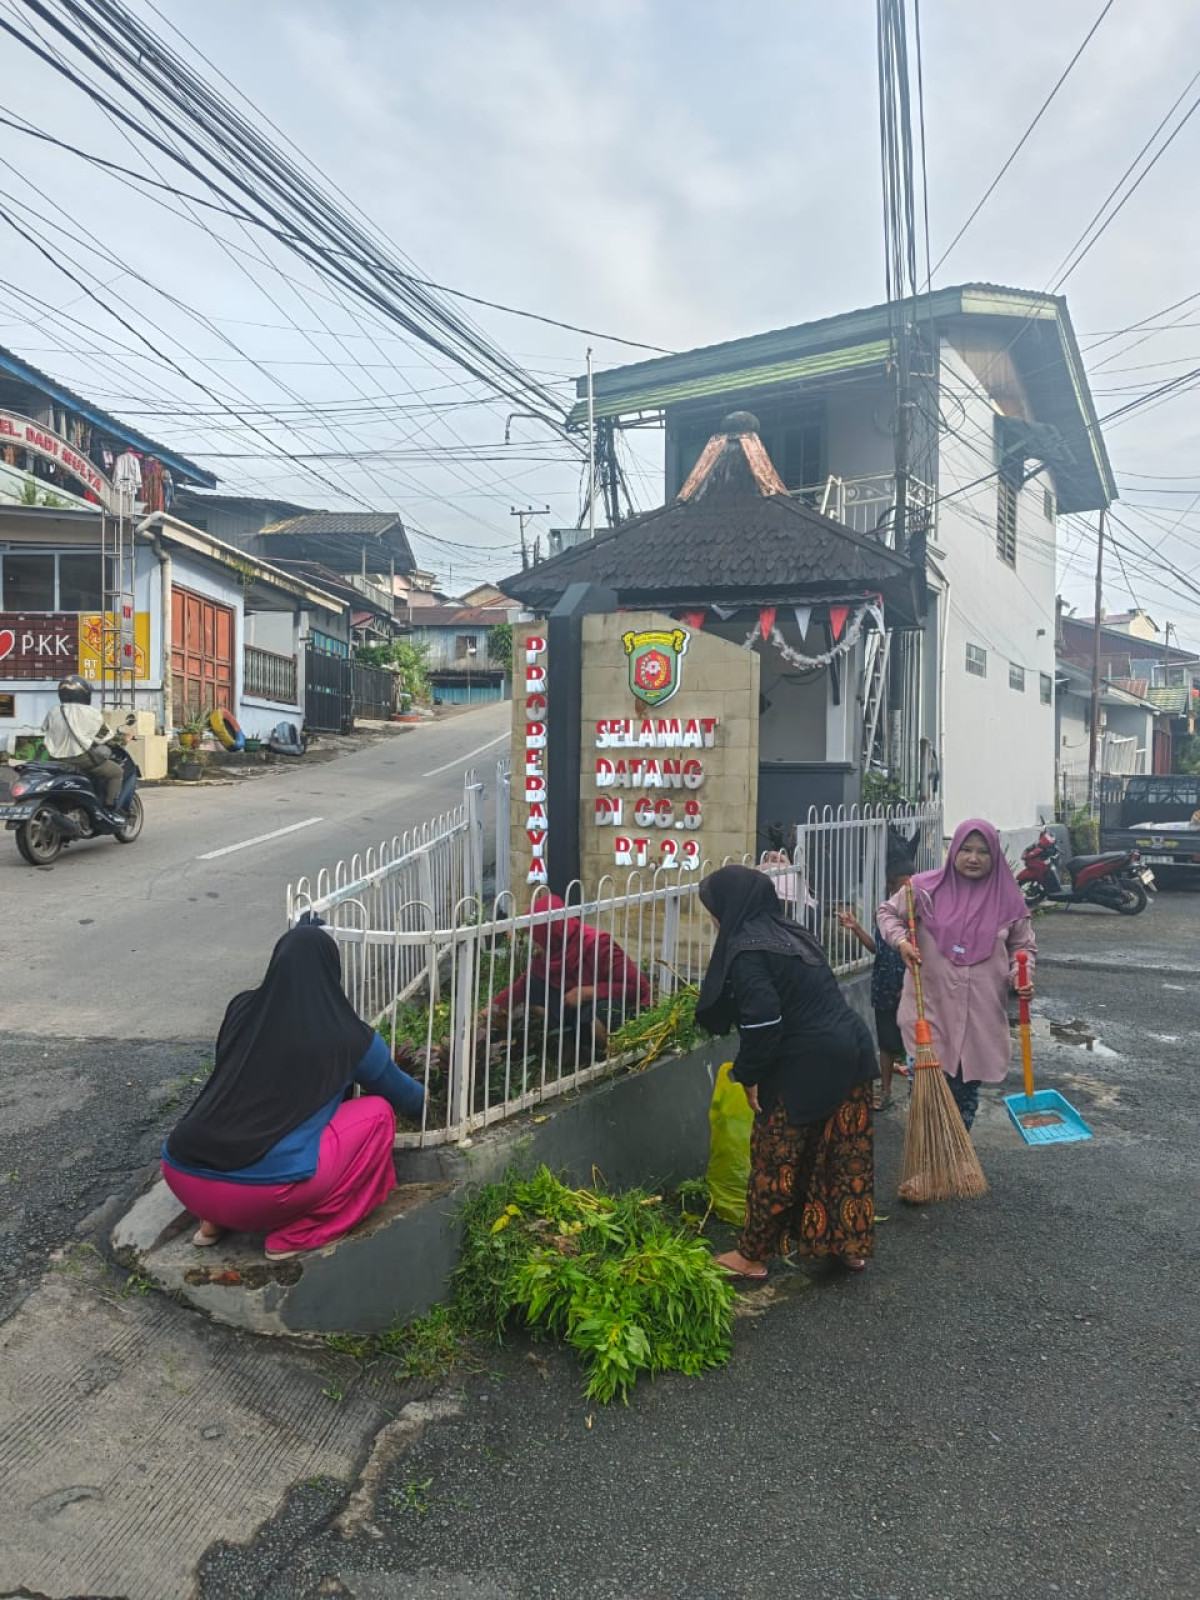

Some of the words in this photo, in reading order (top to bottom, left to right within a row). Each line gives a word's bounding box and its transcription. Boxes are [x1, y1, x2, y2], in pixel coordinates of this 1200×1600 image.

[26, 426, 60, 456] DADI
[61, 447, 102, 492] MULYA
[21, 634, 71, 656] PKK
[595, 718, 719, 749] SELAMAT
[525, 636, 548, 885] PROBEBAYA
[595, 758, 705, 790] DATANG
[594, 797, 623, 826] DI
[634, 797, 702, 830] GG.8
[614, 836, 701, 871] RT.23
